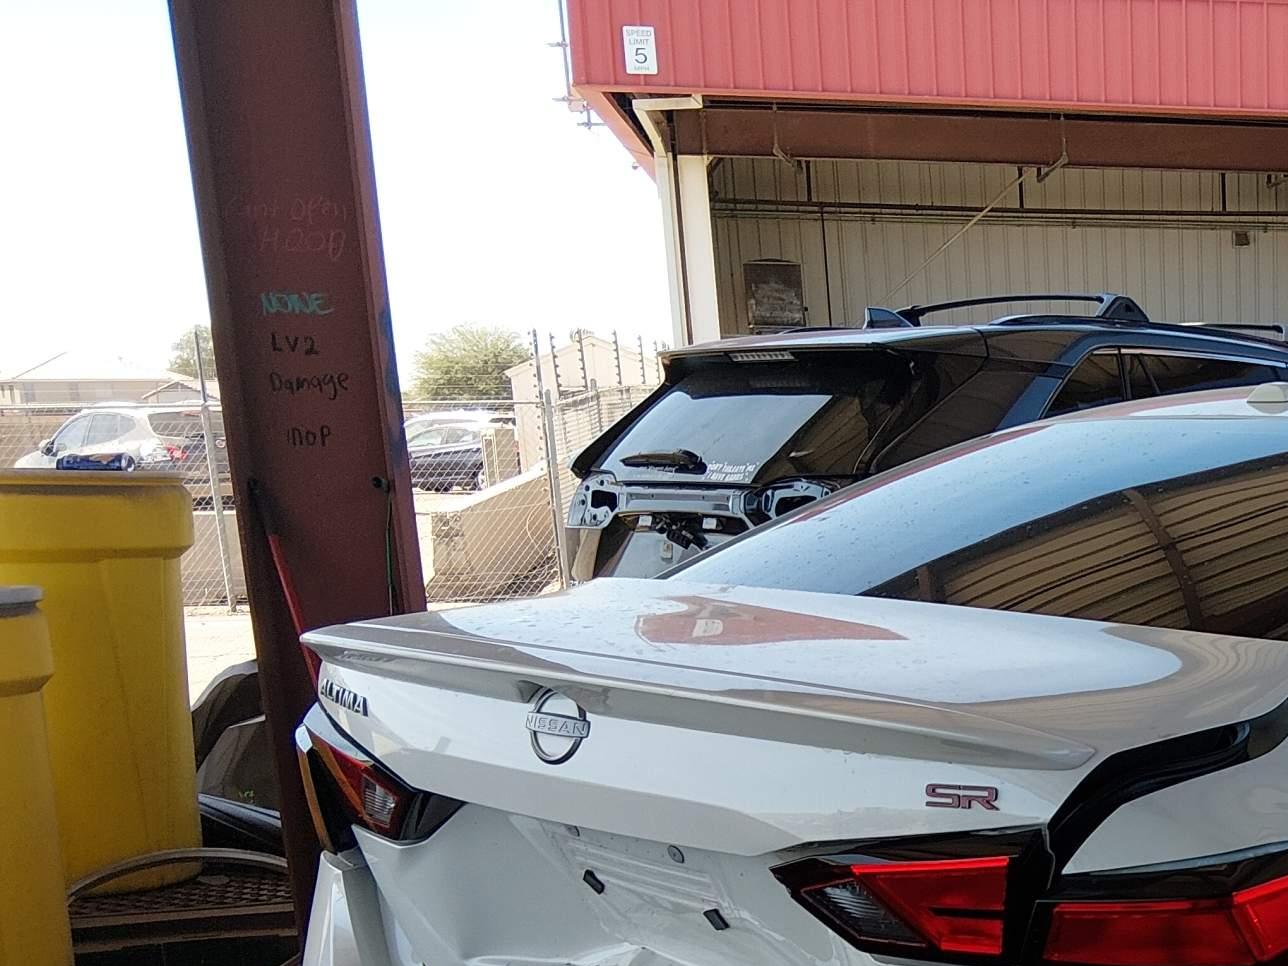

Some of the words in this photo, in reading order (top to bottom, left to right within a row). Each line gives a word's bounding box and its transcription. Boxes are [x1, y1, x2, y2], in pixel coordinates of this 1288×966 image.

[625, 29, 652, 37] SPEED
[629, 38, 650, 46] LIMIT
[634, 47, 648, 64] 5
[271, 332, 320, 357] LV2
[269, 371, 350, 401] Damage
[320, 678, 370, 717] ALTIMA
[525, 712, 588, 737] NISSAN
[925, 783, 1000, 811] SR
